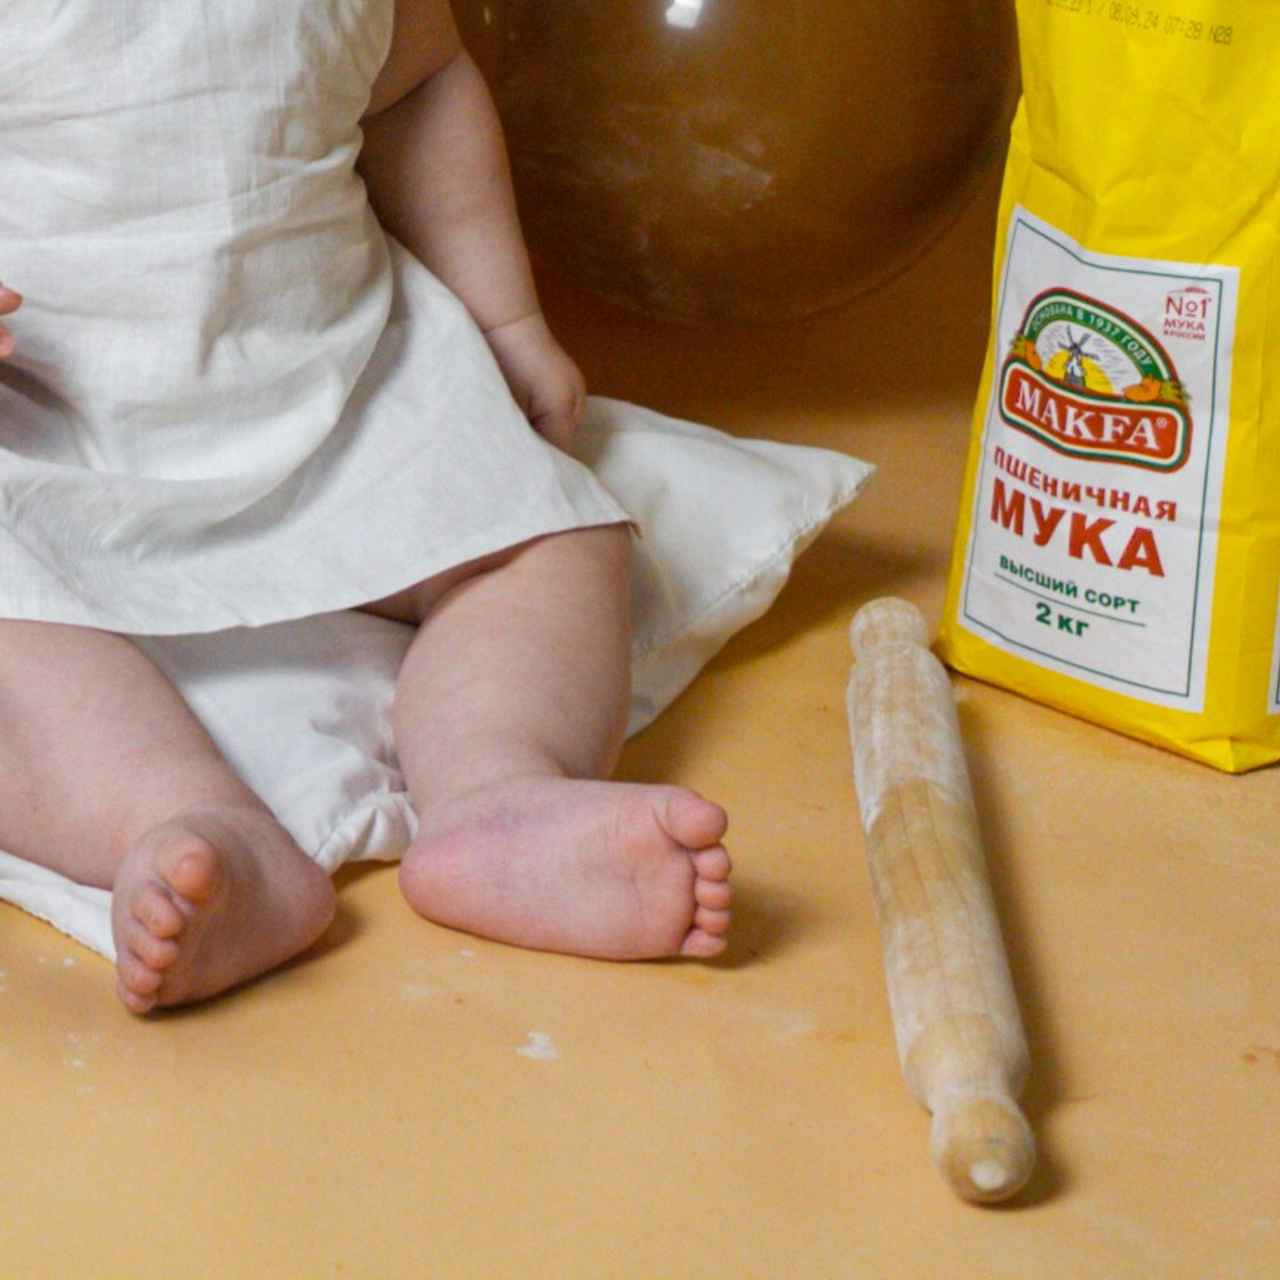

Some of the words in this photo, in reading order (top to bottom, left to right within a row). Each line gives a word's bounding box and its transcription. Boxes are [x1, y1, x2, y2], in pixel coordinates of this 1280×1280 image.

[1031, 303, 1073, 331] ОСНОВАНА
[1076, 309, 1084, 320] В
[1089, 312, 1120, 336] 1937
[1121, 335, 1153, 366] ГОДУ
[1164, 318, 1205, 332] МУКА
[994, 446, 1178, 522] ПШЕНИЧНАЯ
[990, 477, 1165, 578] МУКА
[999, 555, 1078, 598] ВЫСШИЙ
[1084, 589, 1140, 613] СОРТ
[1035, 602, 1052, 625] 2
